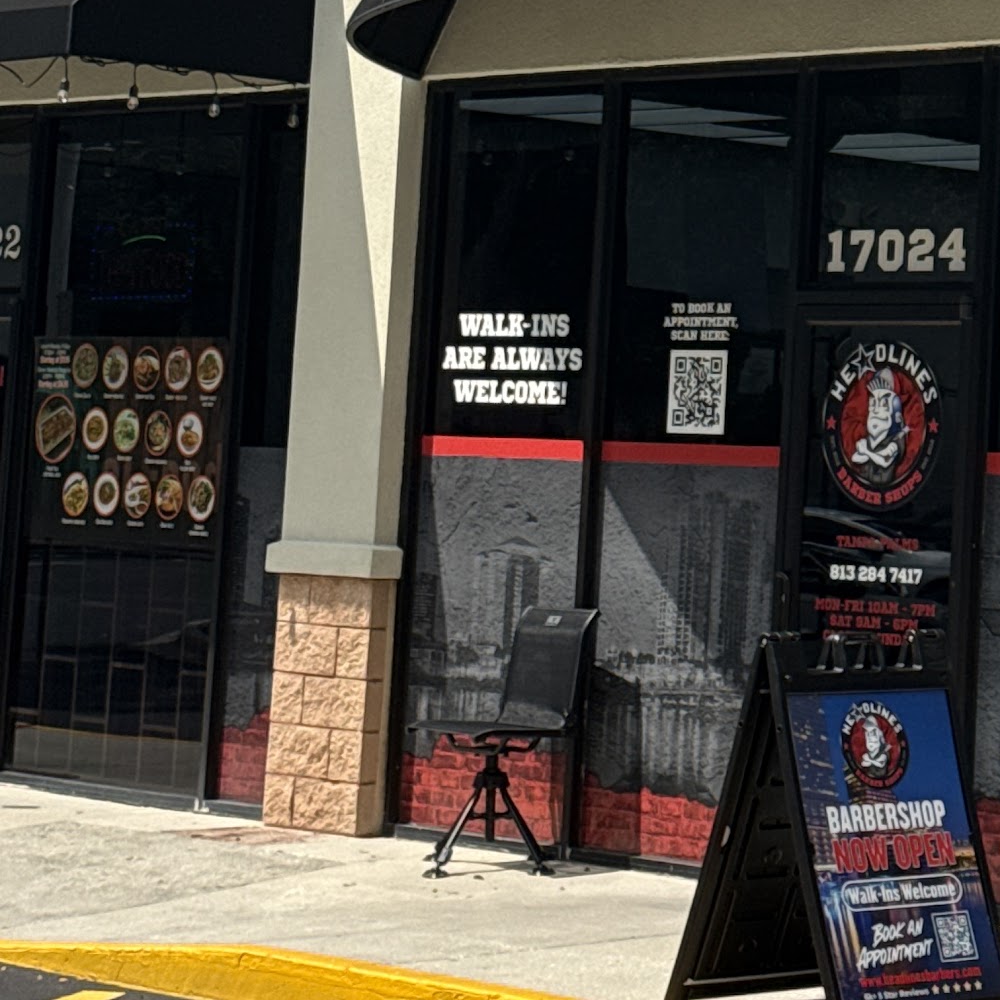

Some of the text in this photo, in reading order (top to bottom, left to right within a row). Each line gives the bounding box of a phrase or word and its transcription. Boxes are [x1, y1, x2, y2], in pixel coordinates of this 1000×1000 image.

[825, 227, 967, 273] 17024
[671, 302, 732, 314] TO BOOK AN
[458, 312, 571, 338] WALK-INS
[670, 329, 698, 341] SCAN
[442, 345, 583, 372] ARE ALWAYS
[453, 379, 569, 406] WELCOME!
[836, 466, 924, 505] BARBER SHOPS
[829, 564, 923, 585] 813 284 7417
[814, 597, 864, 613] MON-FRI
[867, 600, 899, 615] 10AM
[910, 604, 936, 617] 7PM
[829, 614, 852, 627] SAT
[826, 800, 946, 834] BARBERSHOP
[831, 831, 957, 874] NOW OPEN
[846, 880, 957, 905] Walk-Ins Welcome
